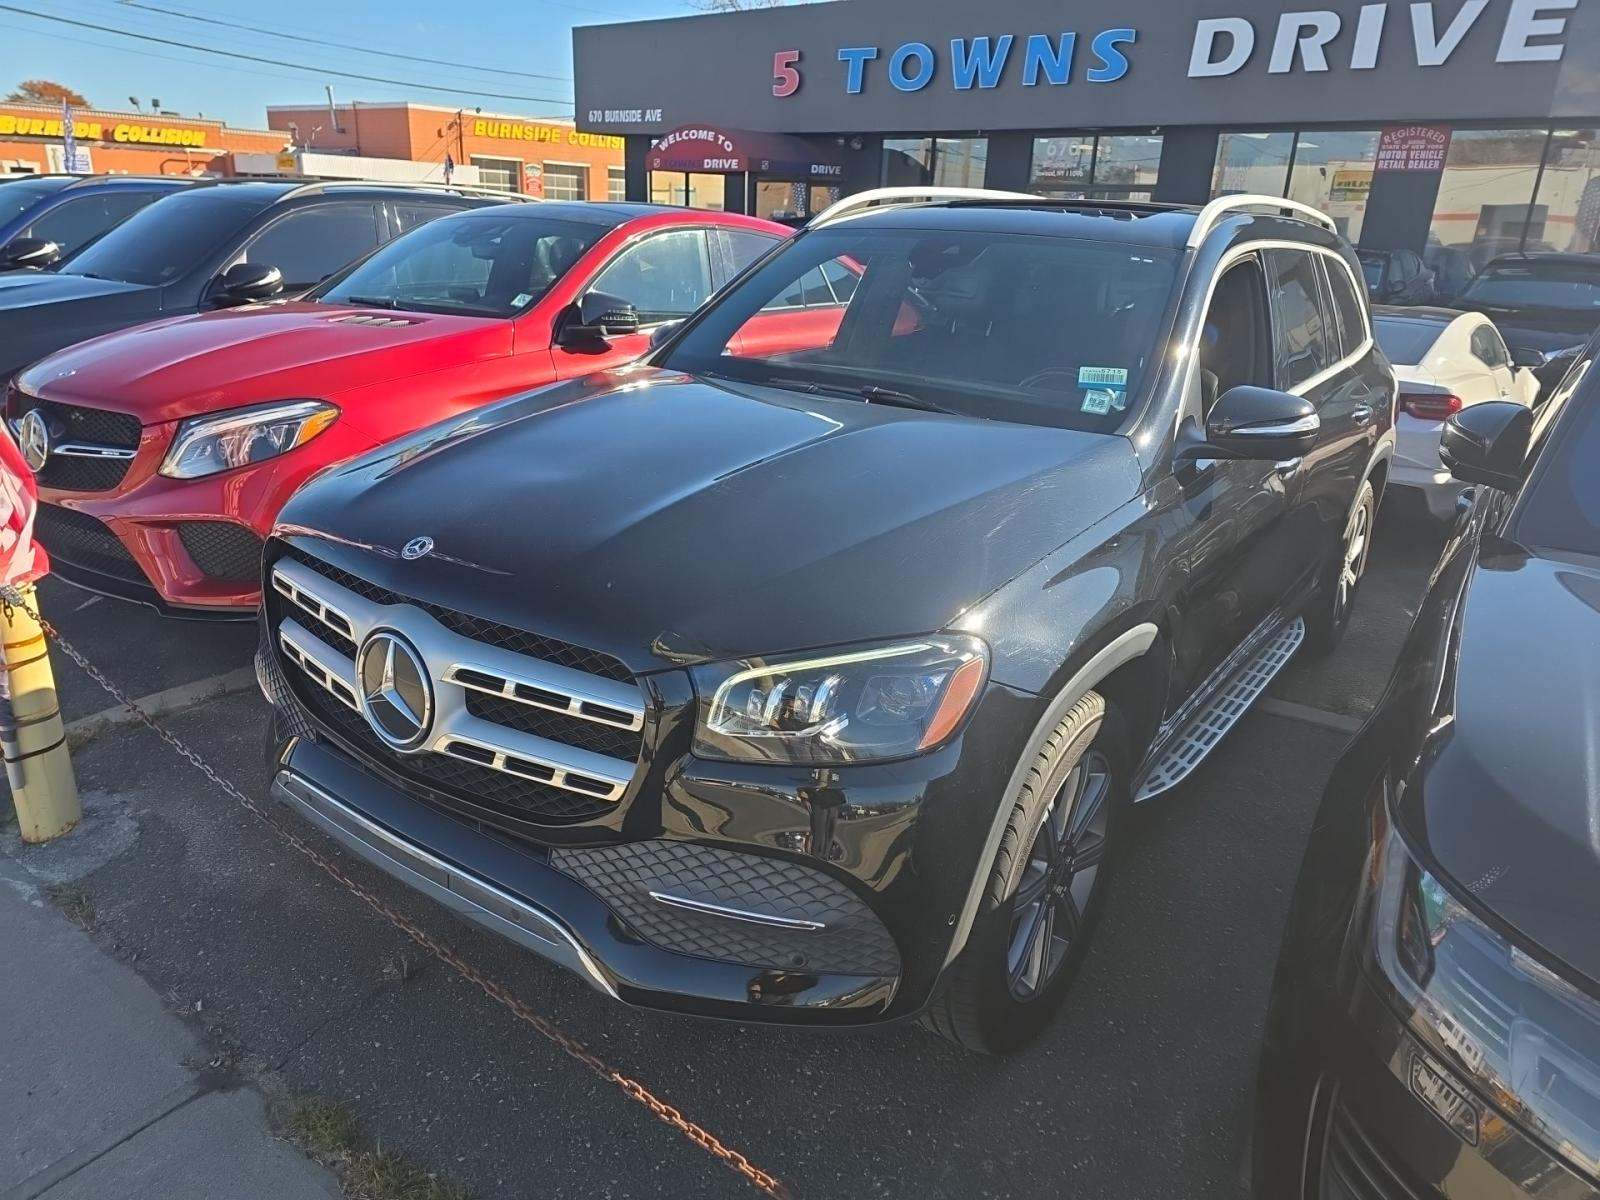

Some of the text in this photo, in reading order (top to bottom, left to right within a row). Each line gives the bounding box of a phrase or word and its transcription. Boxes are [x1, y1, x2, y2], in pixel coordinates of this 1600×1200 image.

[772, 0, 1578, 97] 5 TOWNS DRIVE
[588, 109, 662, 122] 670 BURNSIDE AVE
[114, 124, 206, 147] COLLISION
[475, 119, 560, 143] BURNSIDE
[1383, 127, 1446, 144] REGISTERED
[658, 129, 733, 152] WELCOME TO
[1378, 150, 1445, 160] MOTOR VEHICLE
[703, 159, 739, 169] DRIVE
[811, 164, 842, 175] DRIVE
[1378, 160, 1440, 169] RETAIL DEALER
